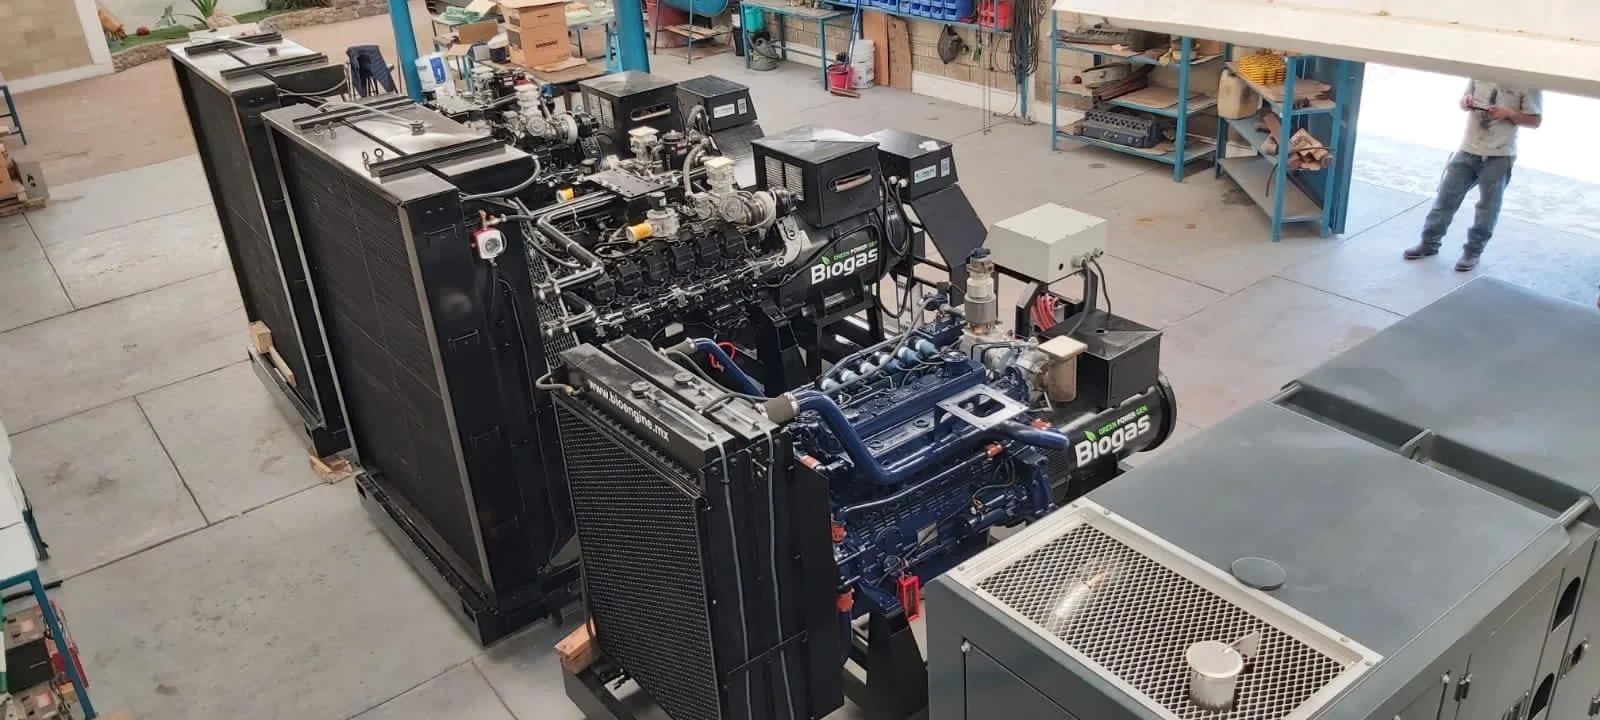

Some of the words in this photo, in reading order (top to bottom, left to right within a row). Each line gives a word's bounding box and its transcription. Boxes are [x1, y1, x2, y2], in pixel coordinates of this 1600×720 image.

[811, 248, 878, 285] Biogas
[588, 379, 669, 441] www.bioengine.mx
[1099, 422, 1117, 435] GREEN
[1075, 414, 1151, 468] Biogas
